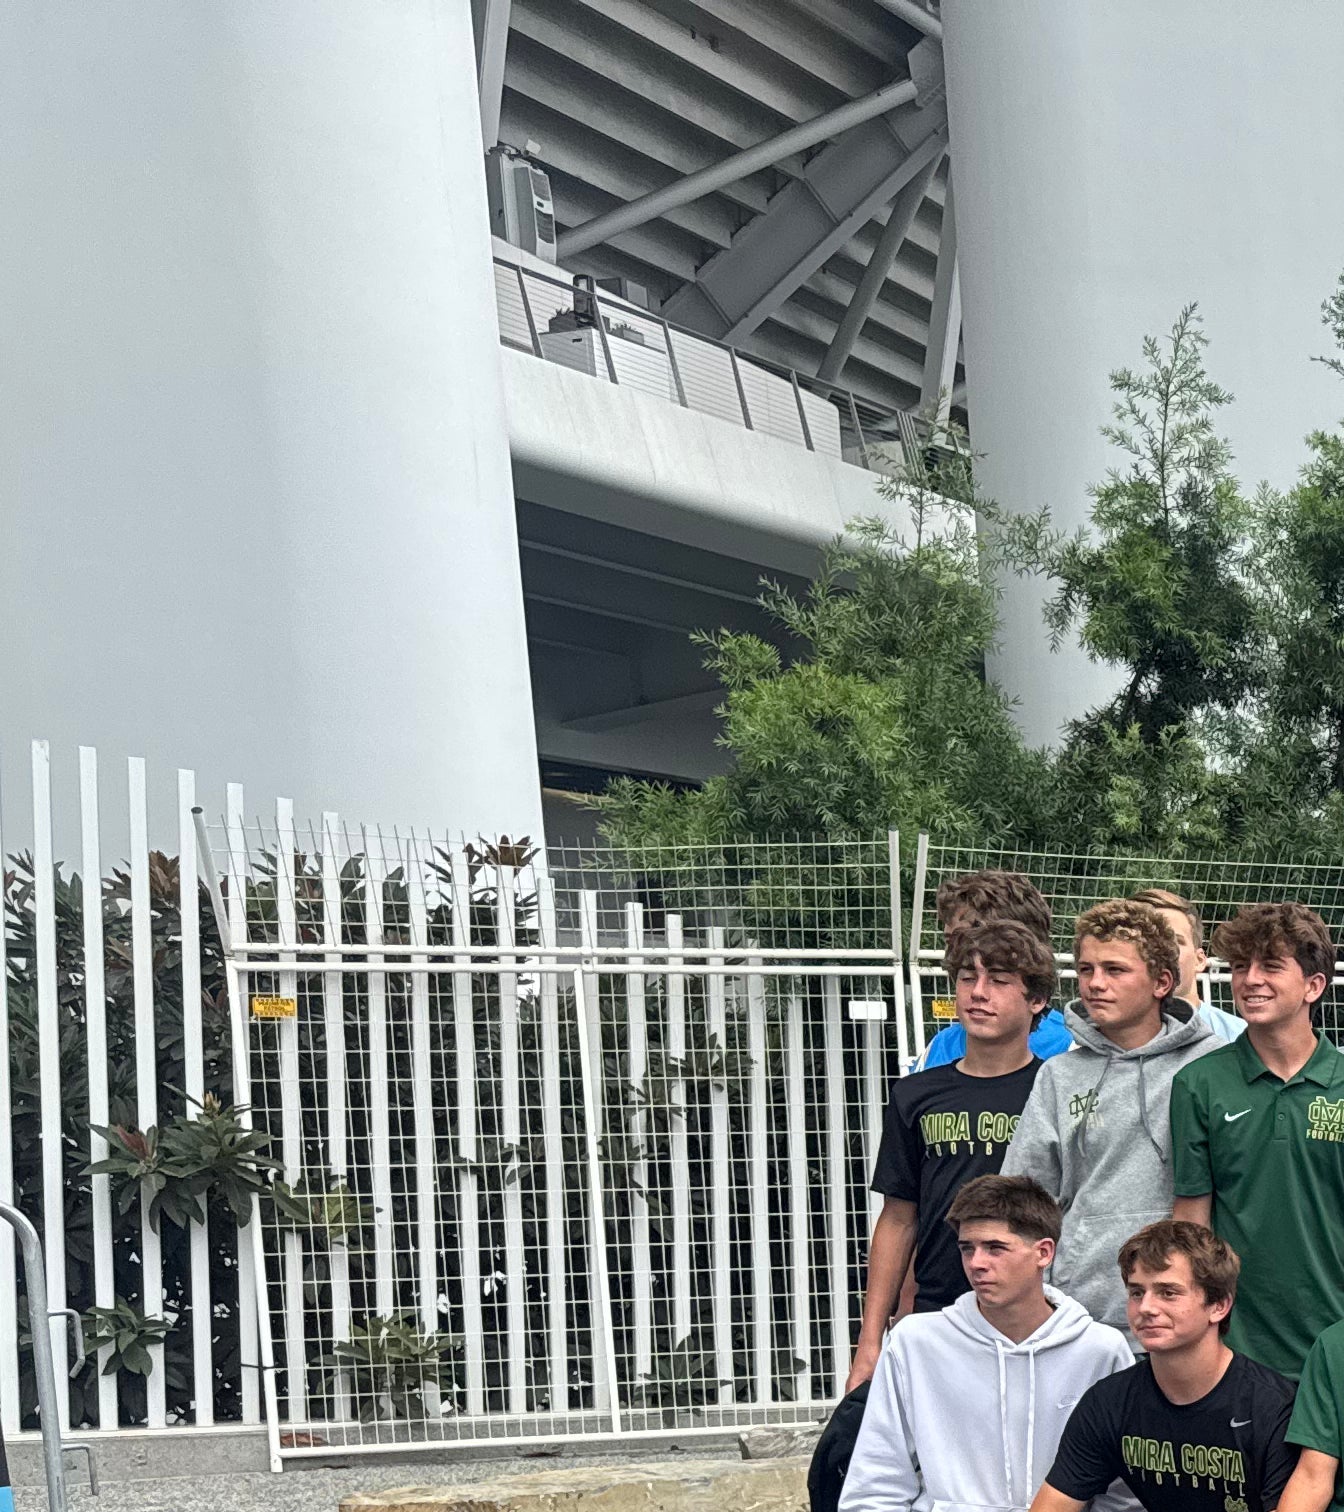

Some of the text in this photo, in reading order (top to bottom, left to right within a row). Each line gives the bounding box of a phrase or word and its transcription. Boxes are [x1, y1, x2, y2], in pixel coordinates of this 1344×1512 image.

[920, 1112, 970, 1145] MIRA
[1122, 1436, 1245, 1484] MIRA COSTA
